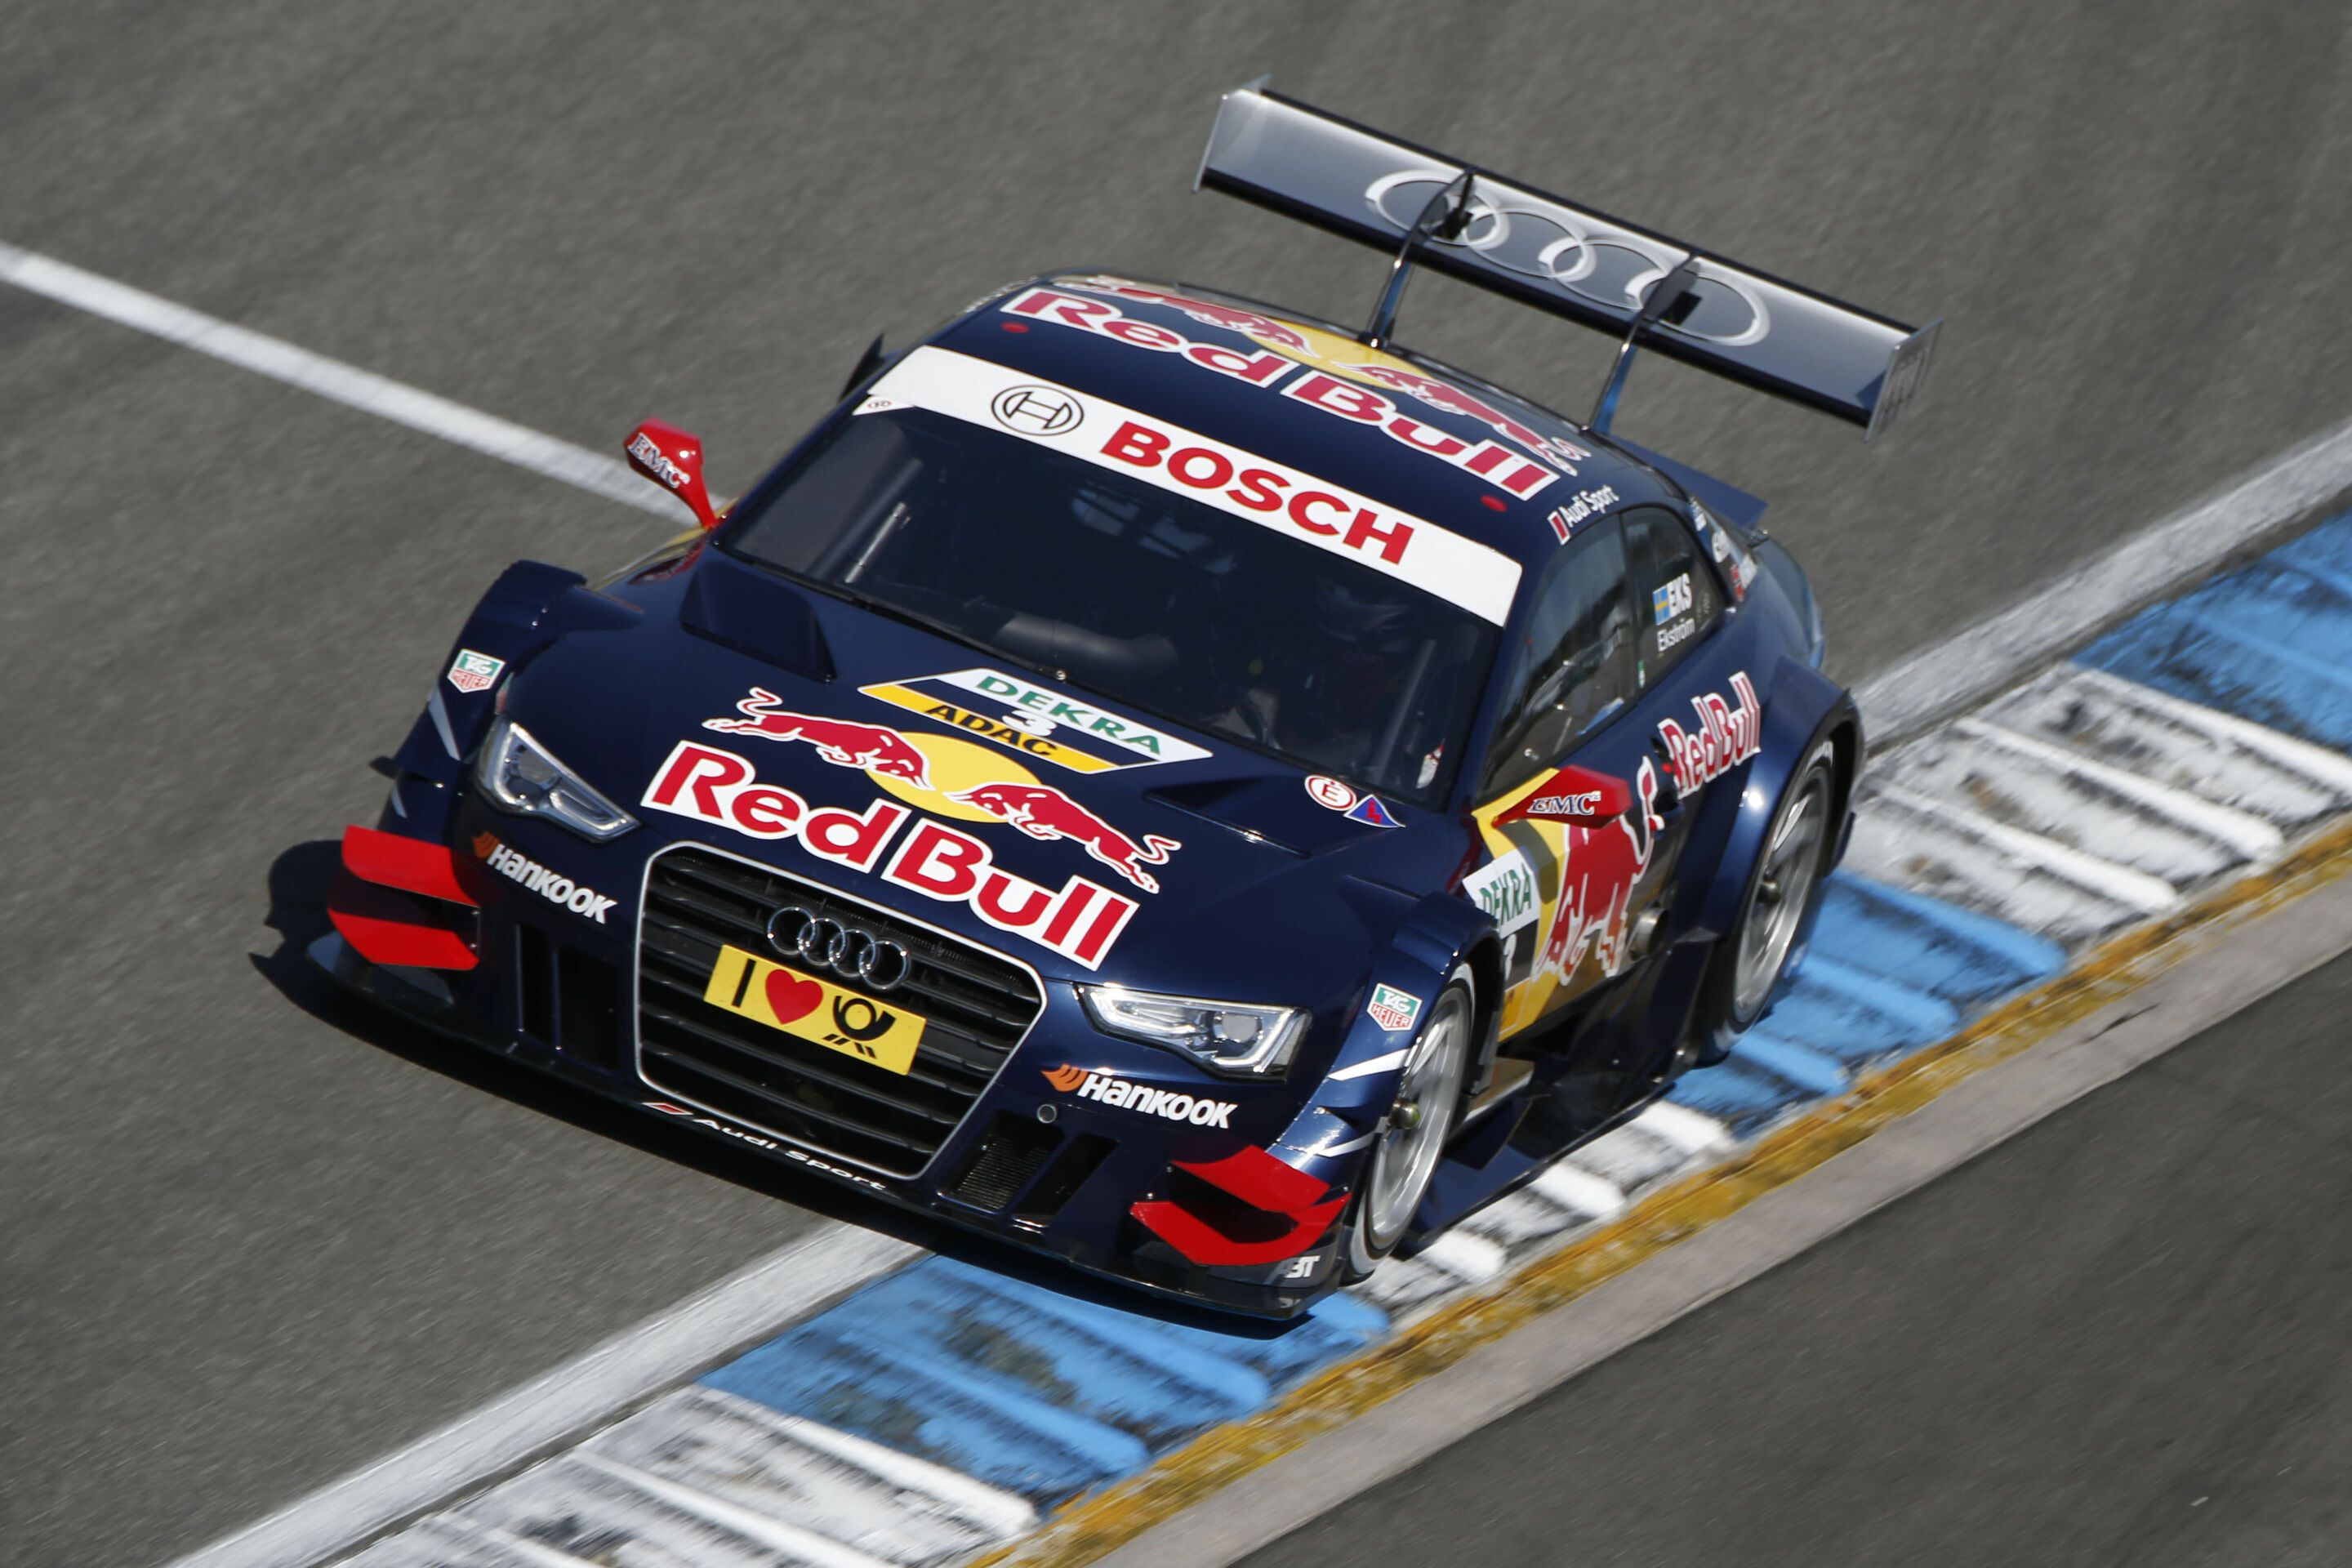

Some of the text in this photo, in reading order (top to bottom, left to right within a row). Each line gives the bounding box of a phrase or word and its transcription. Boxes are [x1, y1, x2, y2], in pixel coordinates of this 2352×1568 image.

[1000, 287, 1561, 501] Red Bull
[1100, 420, 1416, 567] BOSCH
[1557, 483, 1619, 528] Audi Sport
[1667, 572, 1693, 618] EKS
[464, 655, 493, 675] TAG
[924, 704, 1058, 756] ADAC
[976, 675, 1160, 755] DEKRA
[1001, 709, 1058, 737] 3
[640, 739, 1140, 972] Red Bull
[1479, 862, 1532, 931] DEKRA
[1371, 1004, 1411, 1028] HEUER
[1383, 990, 1412, 1013] TAG
[693, 1119, 886, 1191] Audi Sport
